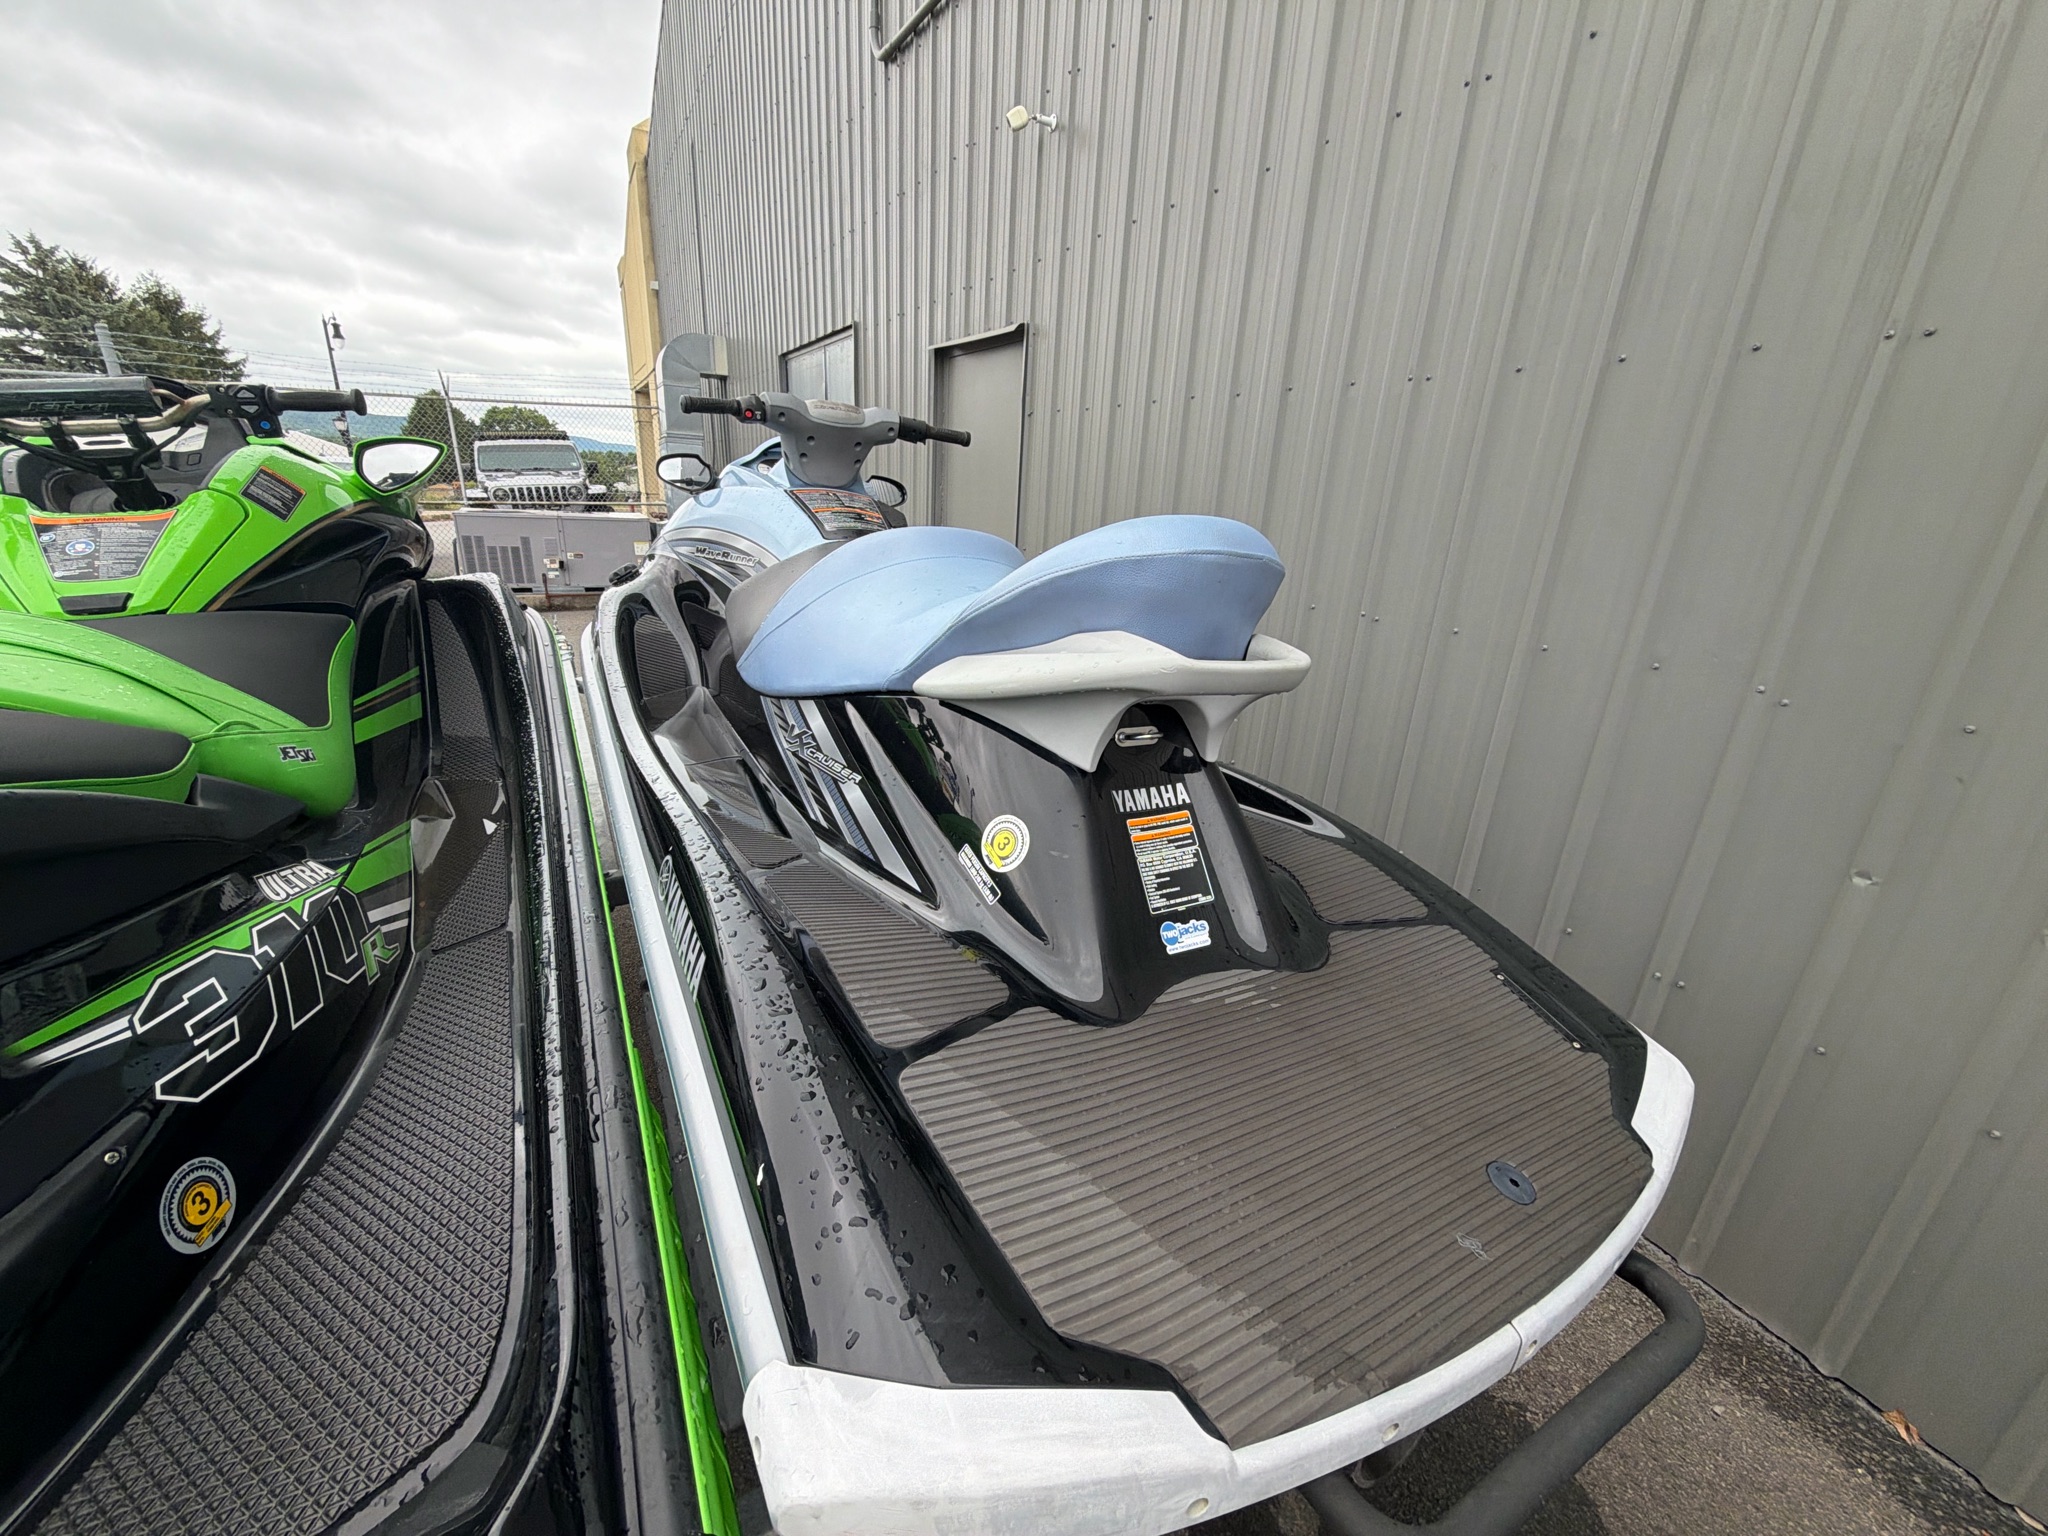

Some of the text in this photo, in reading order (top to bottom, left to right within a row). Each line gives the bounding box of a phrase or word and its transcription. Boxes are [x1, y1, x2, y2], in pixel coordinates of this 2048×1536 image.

[695, 546, 758, 565] WaveRunner
[807, 748, 862, 783] CRUISER
[1112, 782, 1191, 812] YAMAHA
[997, 836, 1010, 851] 3
[255, 859, 339, 901] ULTRA
[665, 872, 707, 1003] YAMAHA
[133, 886, 368, 1102] 310
[191, 1190, 212, 1216] 3
